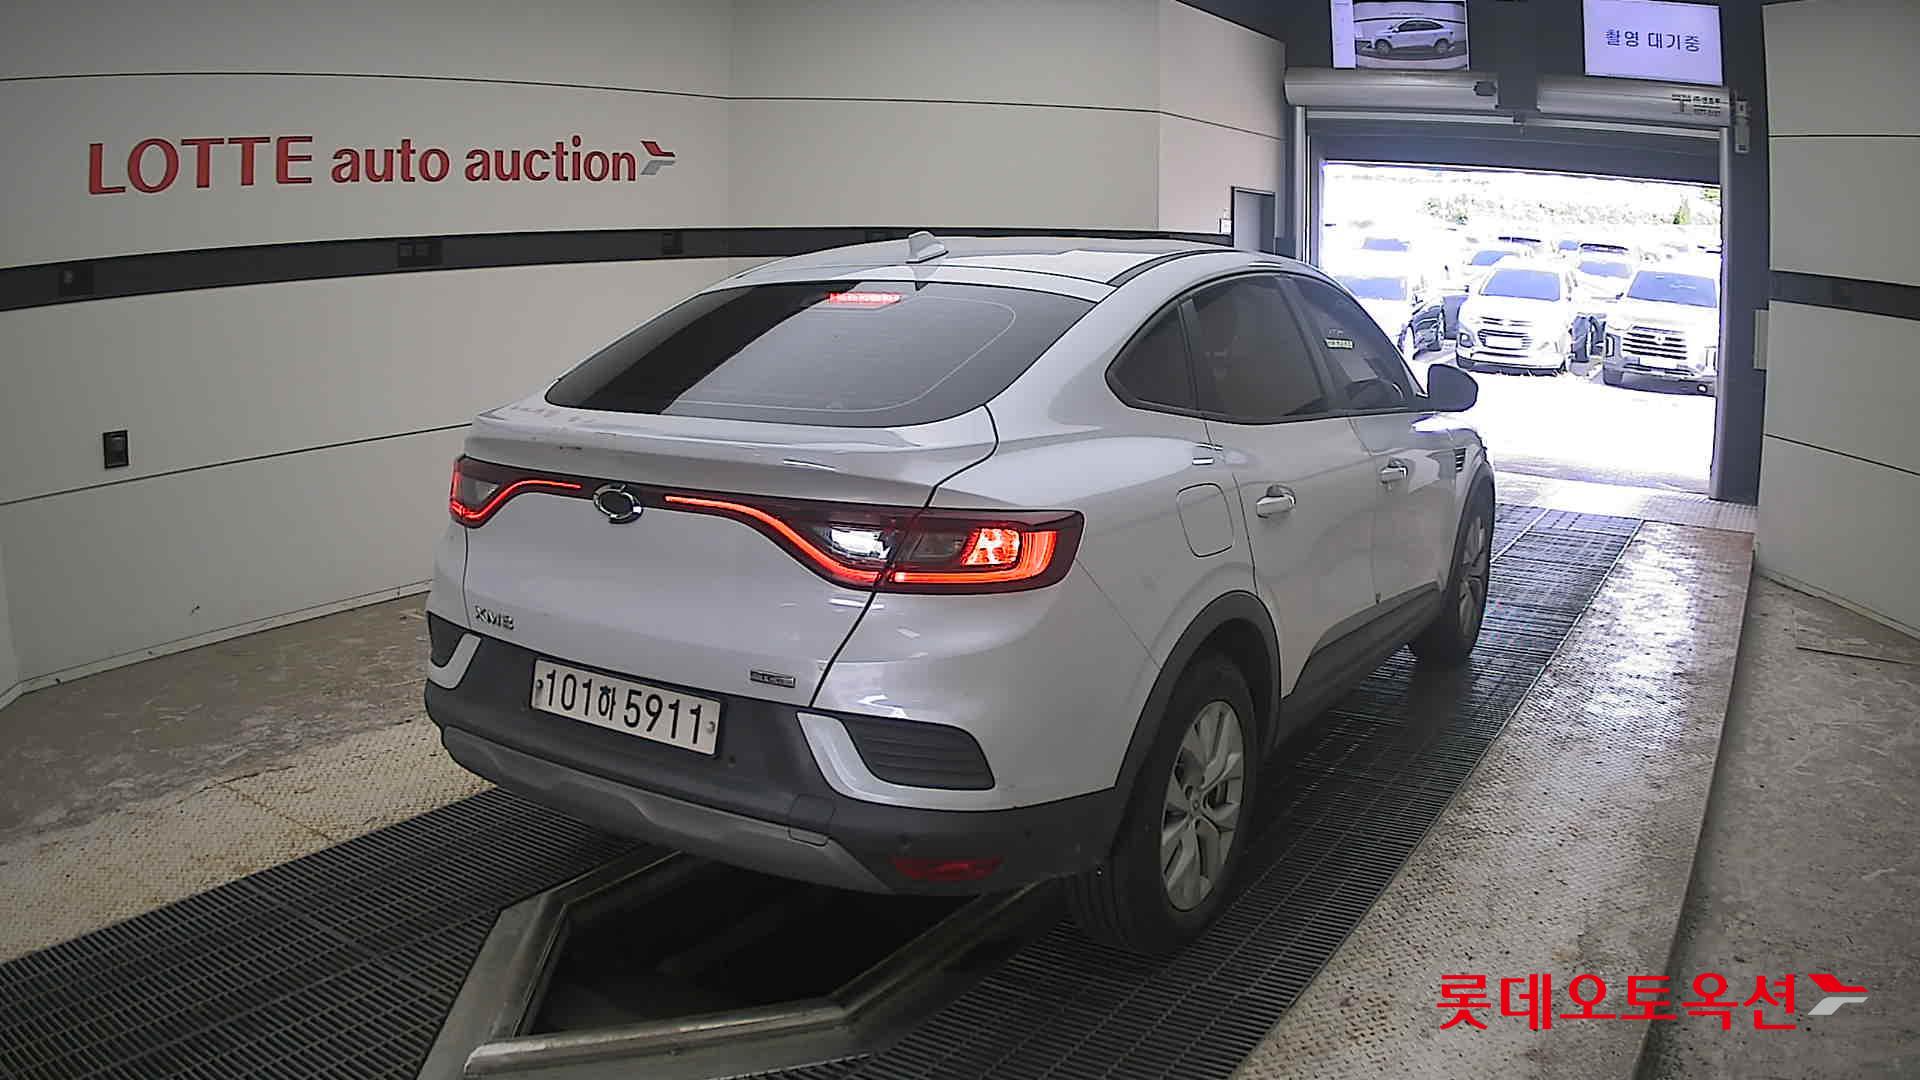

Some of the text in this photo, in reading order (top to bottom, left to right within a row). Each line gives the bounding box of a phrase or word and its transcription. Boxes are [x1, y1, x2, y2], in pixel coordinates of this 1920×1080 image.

[1604, 29, 1701, 52] 촬영 대기중
[88, 135, 638, 195] LOTTE auto auction
